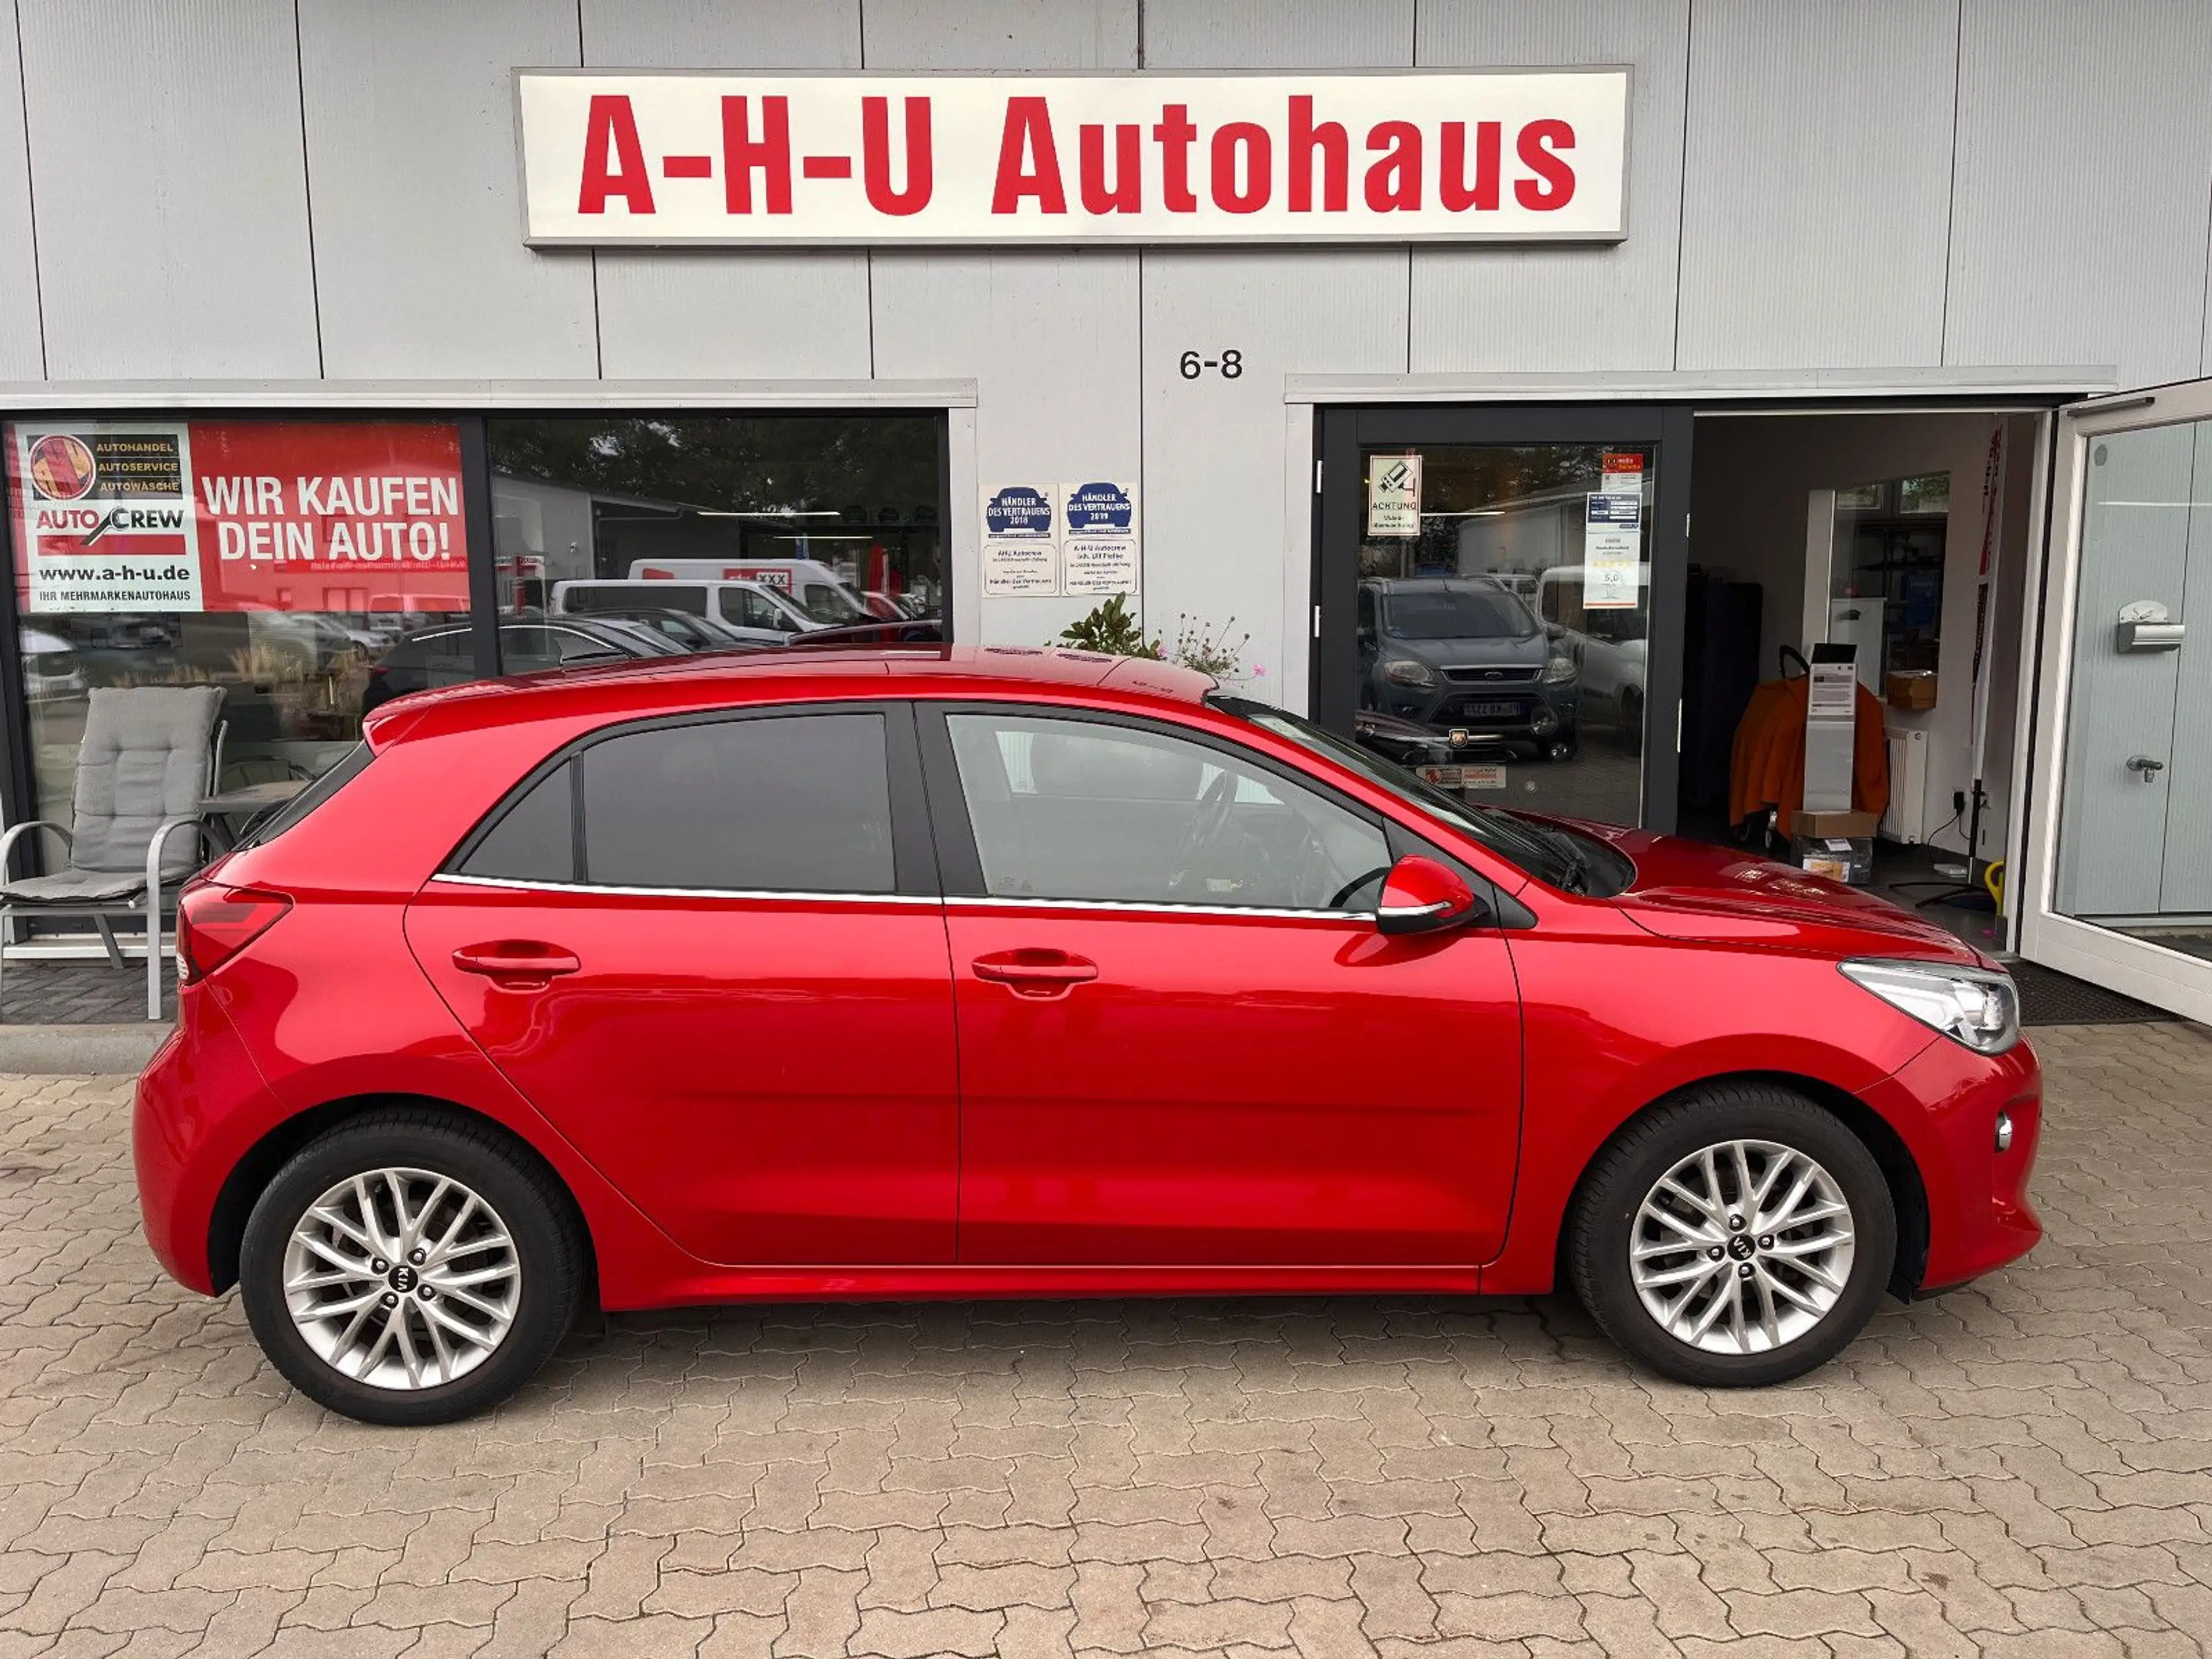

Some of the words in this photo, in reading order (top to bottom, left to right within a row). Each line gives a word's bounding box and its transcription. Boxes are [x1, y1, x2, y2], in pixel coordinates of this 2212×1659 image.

[578, 95, 933, 216] A-H-U
[991, 95, 1576, 214] Autohaus
[1180, 350, 1242, 379] 6-8
[96, 443, 173, 452] AUTOHANDEL
[98, 463, 178, 472] AUTOSERVICE
[201, 476, 284, 516] WIR
[297, 476, 459, 516] KAUFEN
[1001, 496, 1036, 506] HÄNDLER
[1082, 493, 1116, 502] HÄNDLER
[1069, 503, 1082, 512] DES
[1084, 503, 1130, 511] VERTRAUENS
[1373, 501, 1416, 510] ACHTUNG
[988, 507, 1002, 517] DES
[1003, 507, 1050, 517] VERTRAUENS
[36, 510, 99, 529] AUTO
[112, 507, 184, 529] CREW
[1010, 517, 1028, 525] 2018
[218, 522, 315, 560] DEIN
[328, 522, 450, 561] AUTO!
[39, 565, 190, 581] www.a-h-u.de
[39, 591, 56, 601] IHR
[60, 591, 190, 601] MEHRMARKENAUTOHAUS
[398, 1268, 408, 1290] KIA
